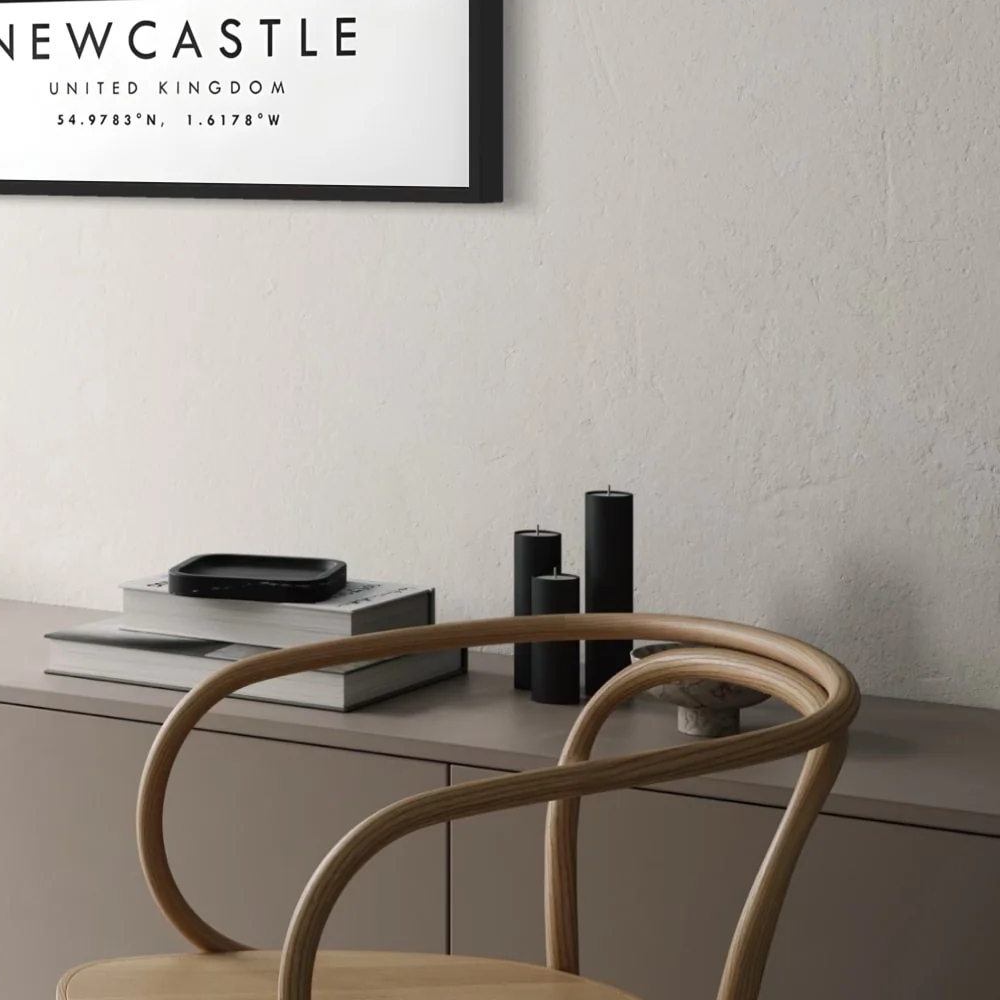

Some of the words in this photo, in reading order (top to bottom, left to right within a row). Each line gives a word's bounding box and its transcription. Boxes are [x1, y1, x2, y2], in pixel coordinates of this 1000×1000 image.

[50, 81, 138, 96] UNITED
[159, 80, 286, 95] KINGDOM
[57, 113, 165, 128] 54.9783°N,
[187, 112, 280, 127] 1.6178°W
